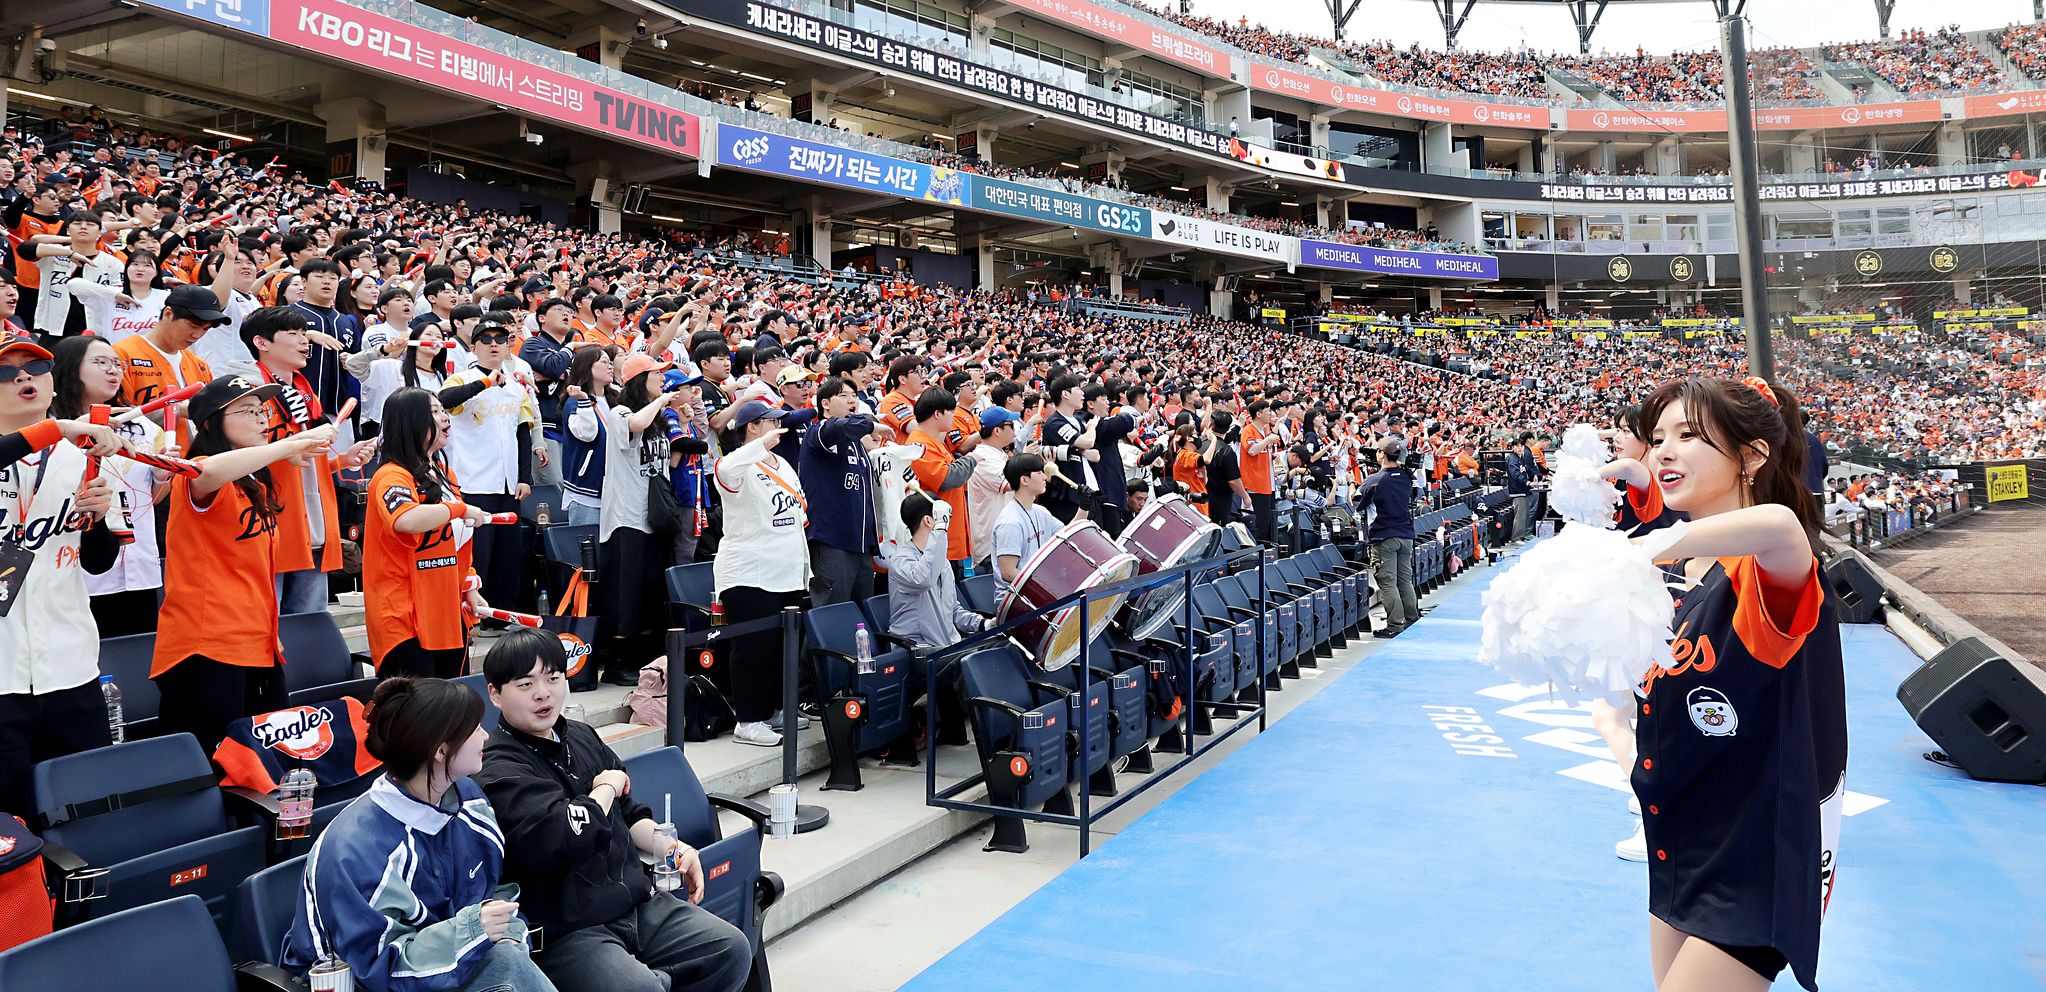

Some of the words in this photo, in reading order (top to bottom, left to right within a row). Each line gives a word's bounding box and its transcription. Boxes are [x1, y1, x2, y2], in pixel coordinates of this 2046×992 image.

[1151, 31, 1214, 69] 브뤼셀프라이
[298, 6, 365, 47] KBO
[366, 27, 435, 70] 리그는
[440, 48, 514, 92] 티빙에서
[518, 75, 583, 112] 스트리밍
[825, 27, 878, 60] 이글스의
[882, 43, 907, 67] 승리
[910, 49, 934, 75] 위해
[937, 59, 962, 82] 안타
[964, 65, 1008, 94] 날려줘요
[1010, 76, 1022, 98] 한
[1024, 80, 1034, 101] 방
[1036, 84, 1077, 113] 날려줘요
[1078, 97, 1115, 124] 이글스의
[1116, 106, 1144, 132] 최재훈
[1187, 126, 1217, 151] 이글스의
[1282, 77, 1310, 94] 한화오션
[1346, 92, 1377, 106] 한화오션
[1414, 102, 1450, 117] 한화솔루션
[1492, 110, 1531, 122] 한화솔루션
[1864, 108, 1903, 119] 한화생명
[593, 90, 686, 148] TVING
[1612, 115, 1686, 127] 한화에어로스페이스
[958, 133, 975, 148] 208
[330, 152, 353, 176] 107
[788, 145, 843, 178] 진짜가
[846, 157, 882, 185] 되는
[884, 168, 918, 192] 시간
[1586, 186, 1624, 201] 이글스의
[1625, 187, 1645, 201] 승리
[1647, 186, 1666, 201] 위해
[1668, 187, 1687, 201] 안타
[1688, 187, 1728, 201] 날려줘요
[1799, 183, 1841, 198] 이글스의
[1843, 180, 1877, 196] 최재훈
[1939, 173, 1985, 191] 이글스의
[985, 185, 1028, 210] 대한민국
[1030, 193, 1051, 212] 대표
[1053, 197, 1082, 220] 편의점
[1097, 204, 1142, 233] GS25
[1177, 220, 1199, 232] LIFE
[1178, 231, 1199, 242] PLUS
[1214, 230, 1238, 248] LIFE
[1241, 234, 1251, 249] IS
[1255, 236, 1280, 254] PLAY
[1316, 248, 1362, 264] MEDIHEAL
[1374, 254, 1422, 270] MEDIHEAL
[1859, 257, 1878, 271] 23
[1436, 259, 1484, 273] MEDIHEAL
[1674, 263, 1688, 277] 21
[112, 316, 158, 332] Eagle
[844, 472, 860, 491] 64
[1995, 480, 2023, 496] STANLEY
[418, 556, 457, 569] 한화손해보험
[703, 654, 710, 664] 3
[849, 704, 857, 715] 2
[252, 708, 333, 748] Eagles
[1421, 704, 1520, 759] FRESH
[1015, 761, 1021, 772] 1
